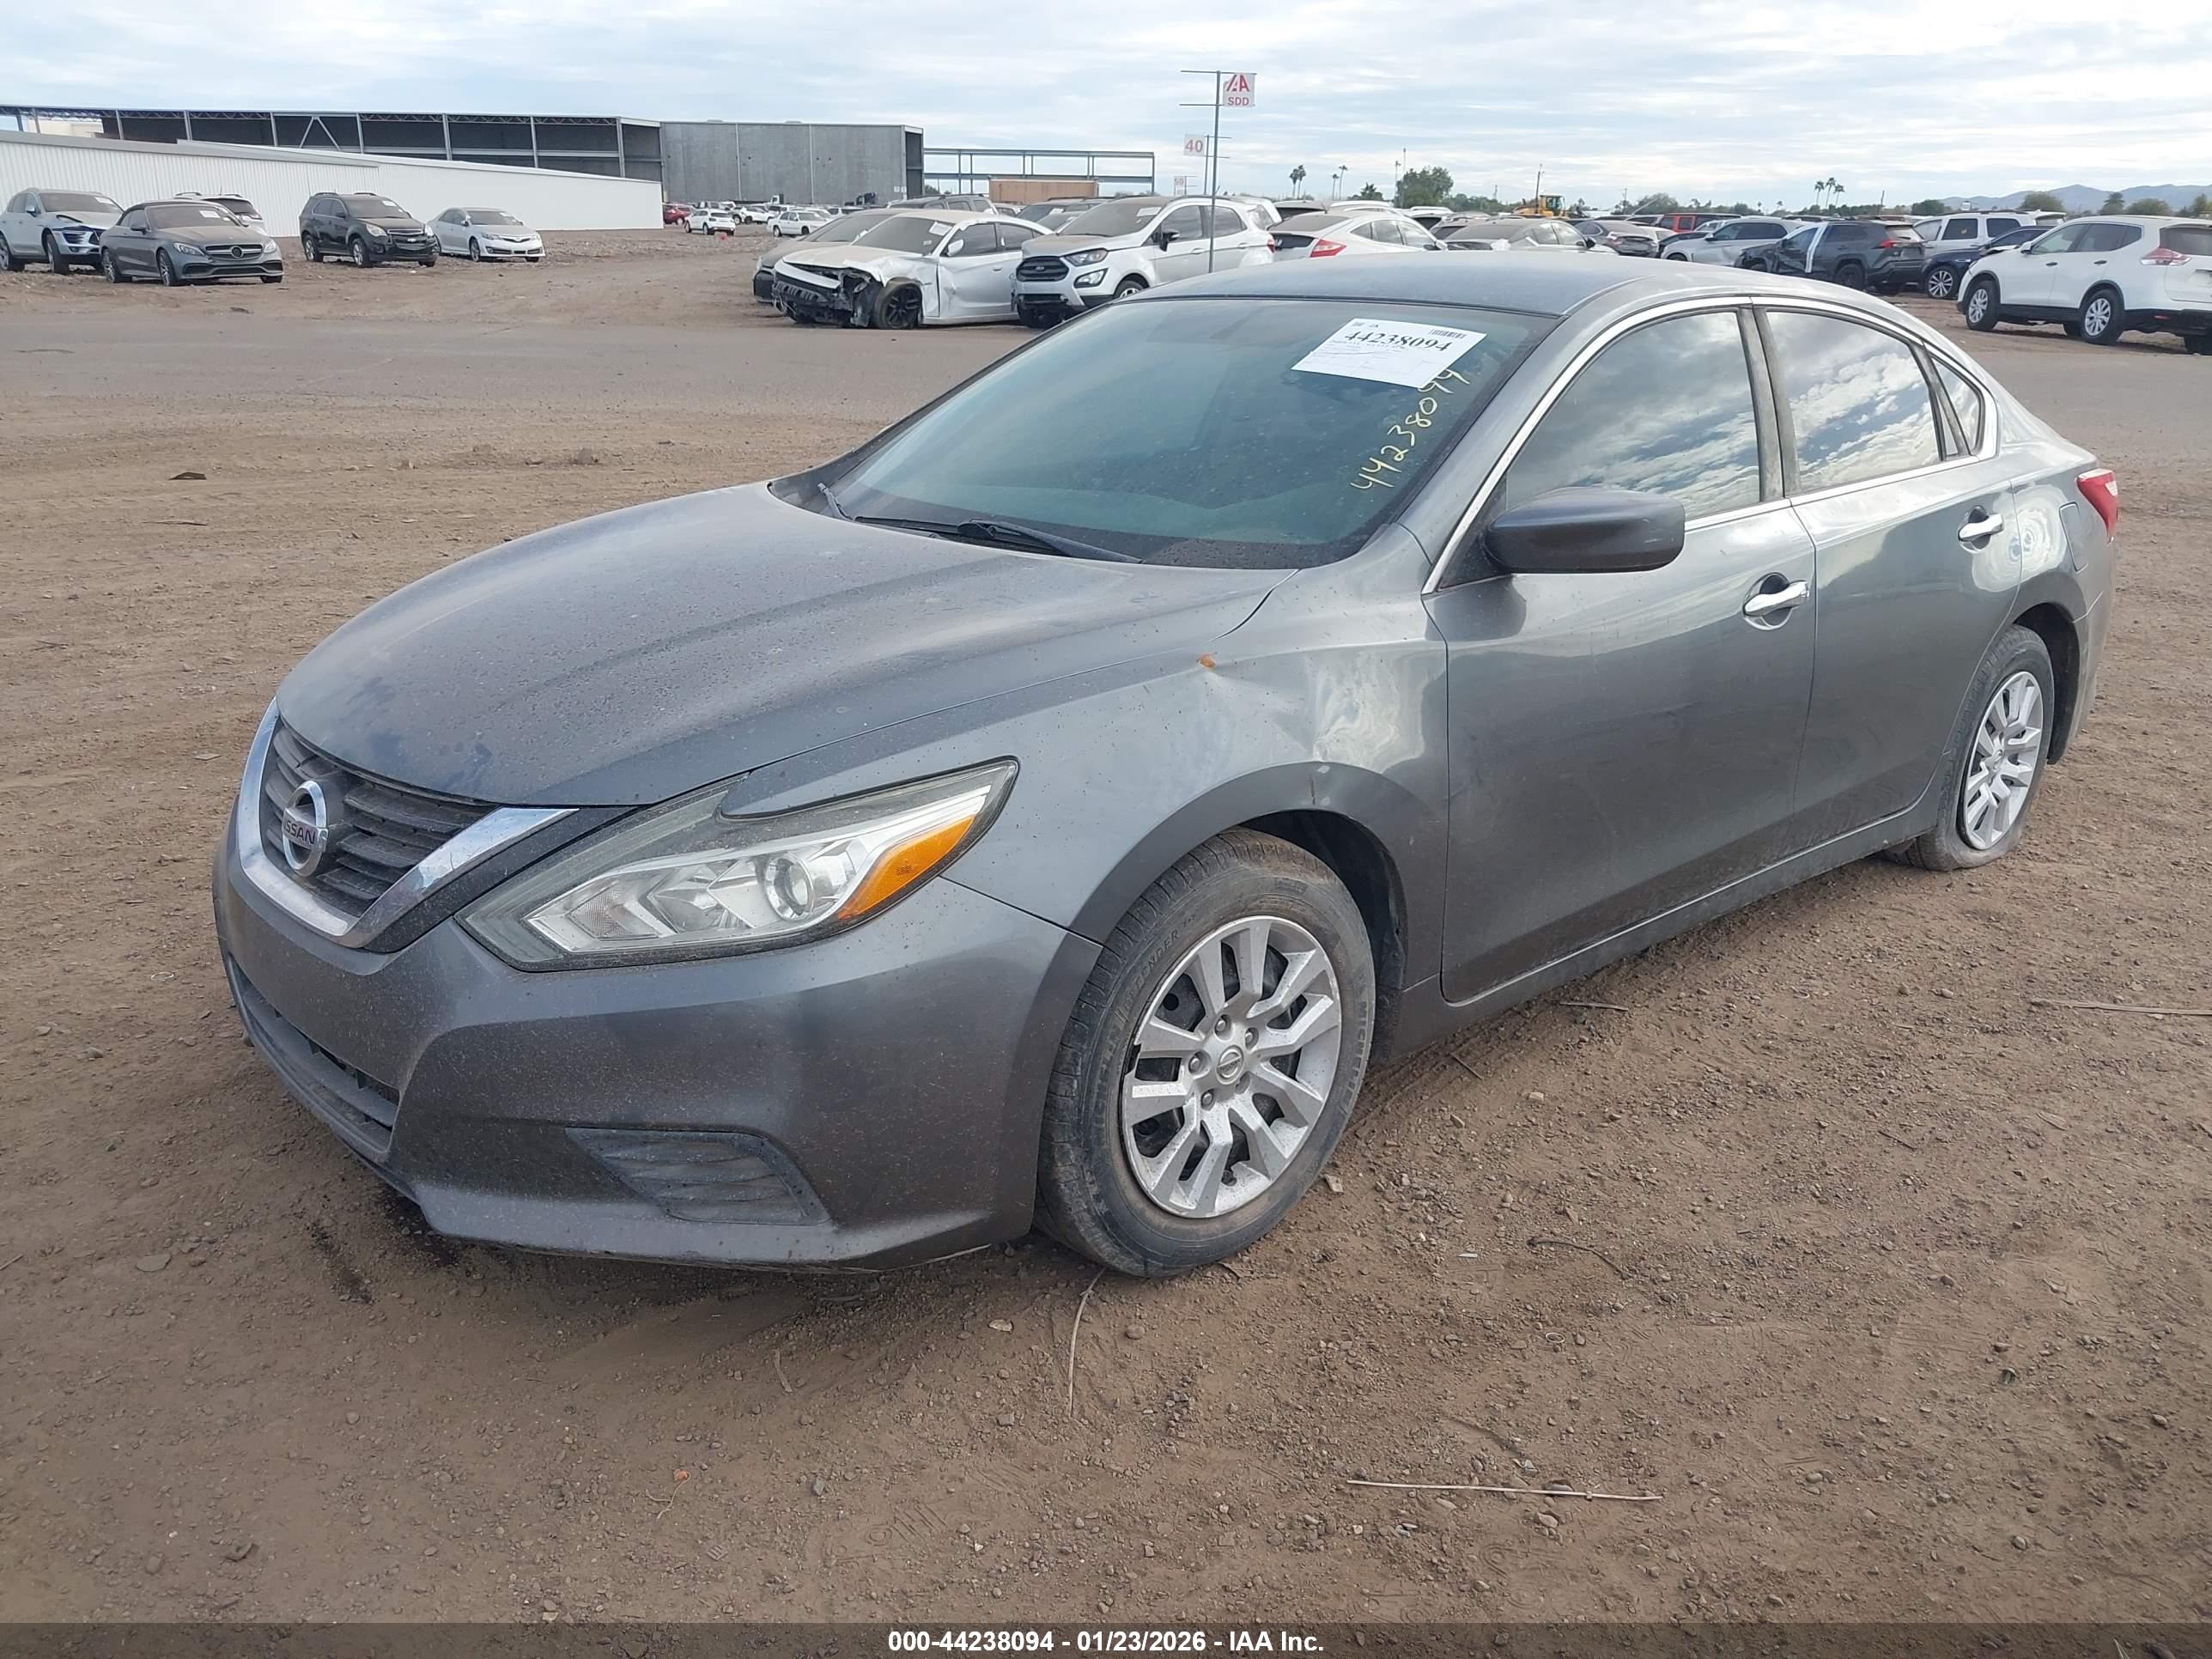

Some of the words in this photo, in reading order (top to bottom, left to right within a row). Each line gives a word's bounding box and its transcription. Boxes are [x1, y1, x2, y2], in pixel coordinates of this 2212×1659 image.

[1227, 96, 1249, 106] SDD
[1185, 140, 1203, 153] 40
[1345, 331, 1454, 352] 44238094
